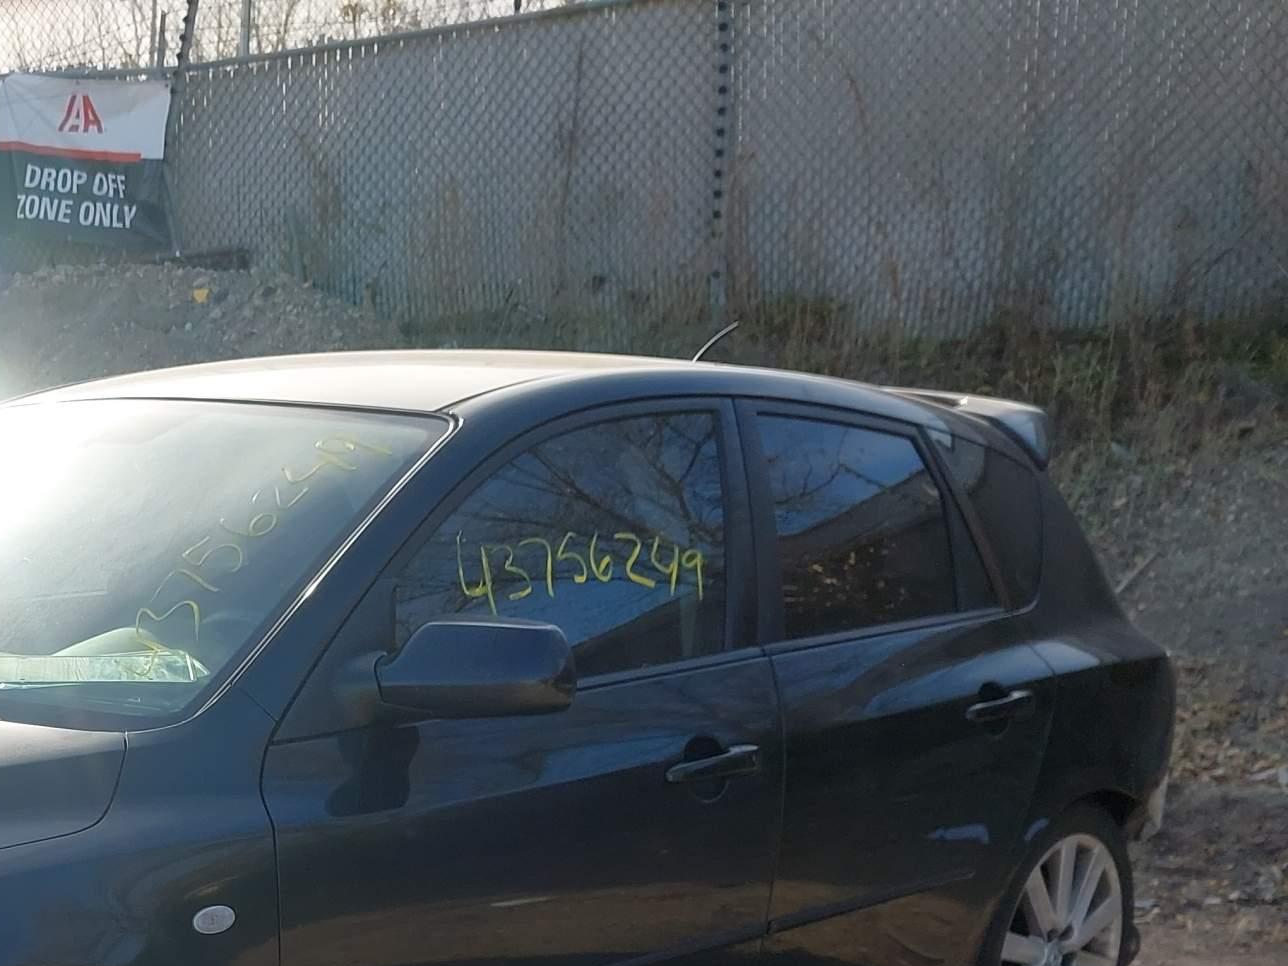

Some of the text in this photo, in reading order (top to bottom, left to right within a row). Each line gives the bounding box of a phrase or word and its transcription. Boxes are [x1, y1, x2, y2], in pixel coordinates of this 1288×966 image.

[23, 163, 126, 199] DROP OFF
[16, 194, 137, 229] ZONE ONLY
[456, 530, 704, 616] 43756249
